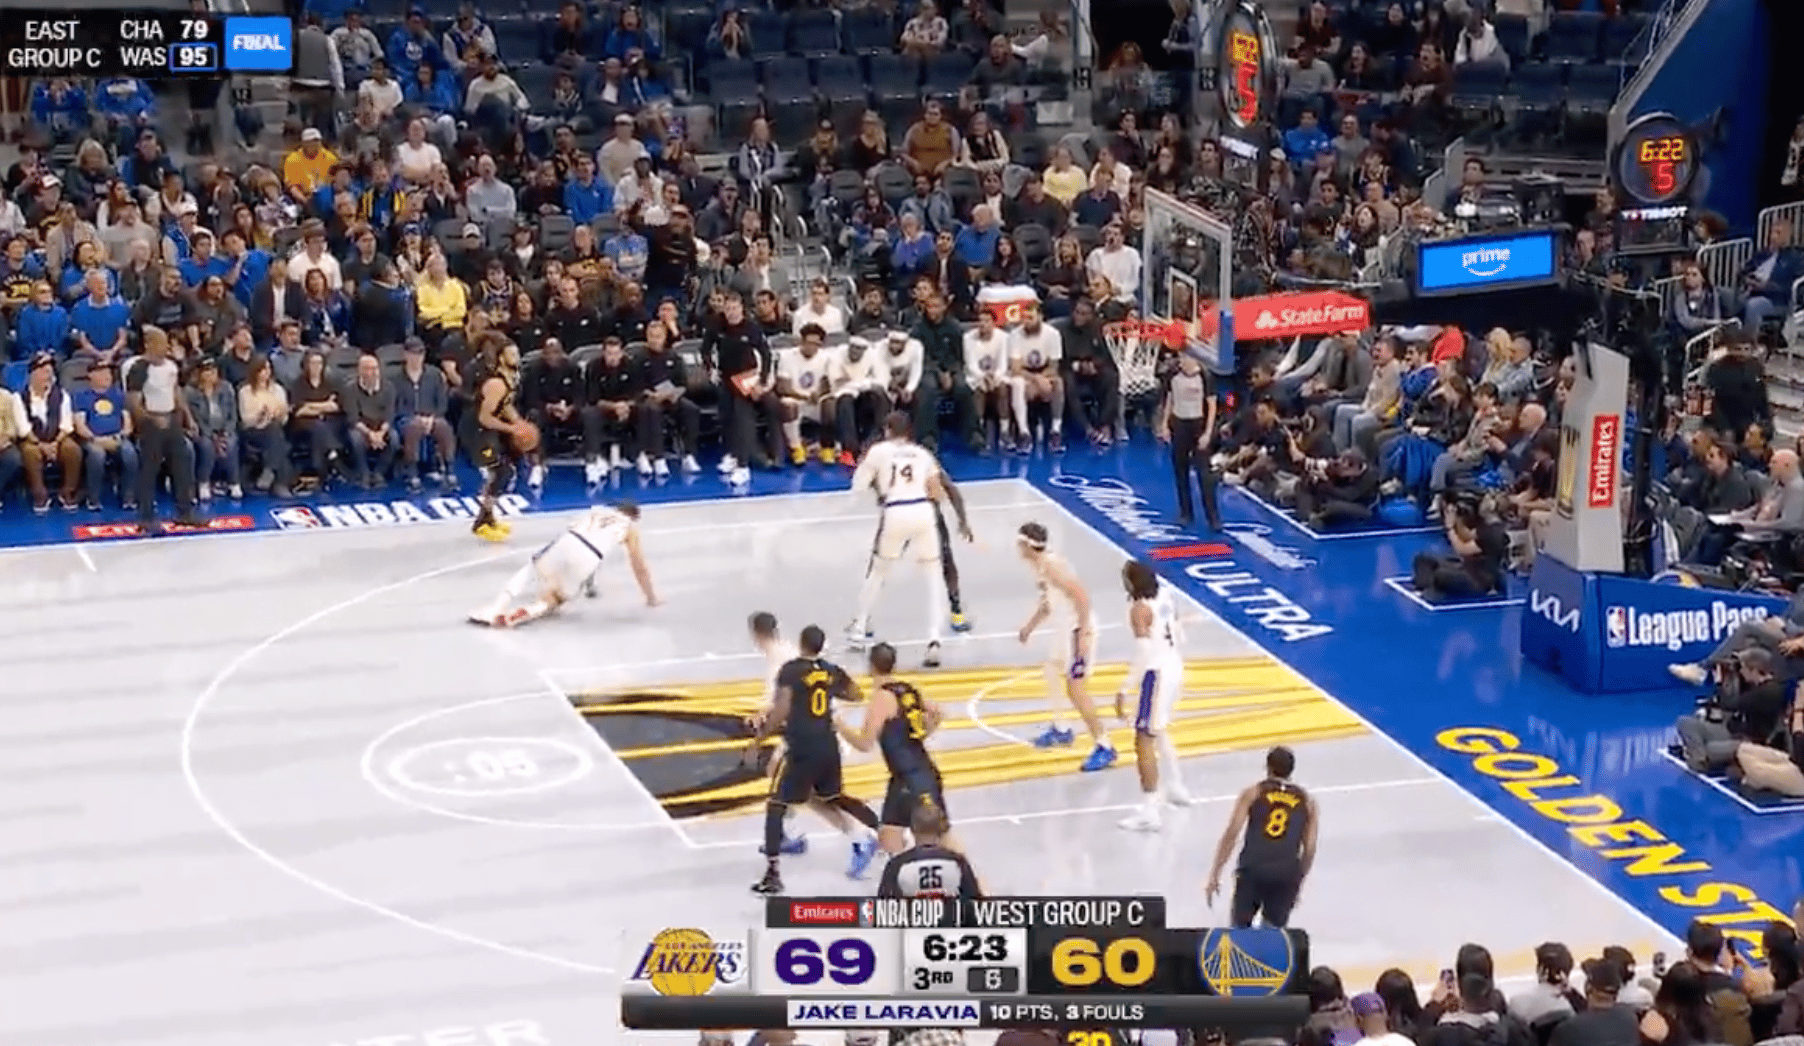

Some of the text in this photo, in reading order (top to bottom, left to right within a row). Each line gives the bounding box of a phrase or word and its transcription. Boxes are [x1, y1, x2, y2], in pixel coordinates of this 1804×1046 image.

[1641, 139, 1684, 161] 6:22
[1657, 162, 1673, 190] 5
[1462, 247, 1511, 268] prime
[1005, 304, 1021, 322] G
[1591, 420, 1616, 502] Emirates
[888, 463, 913, 488] 14
[317, 500, 432, 528] NBA
[1184, 560, 1334, 643] ULTRA
[1628, 605, 1711, 652] League
[811, 687, 827, 716] 0
[1434, 726, 1714, 877] GOLDEN
[1265, 807, 1289, 837] 8
[918, 865, 943, 889] 25
